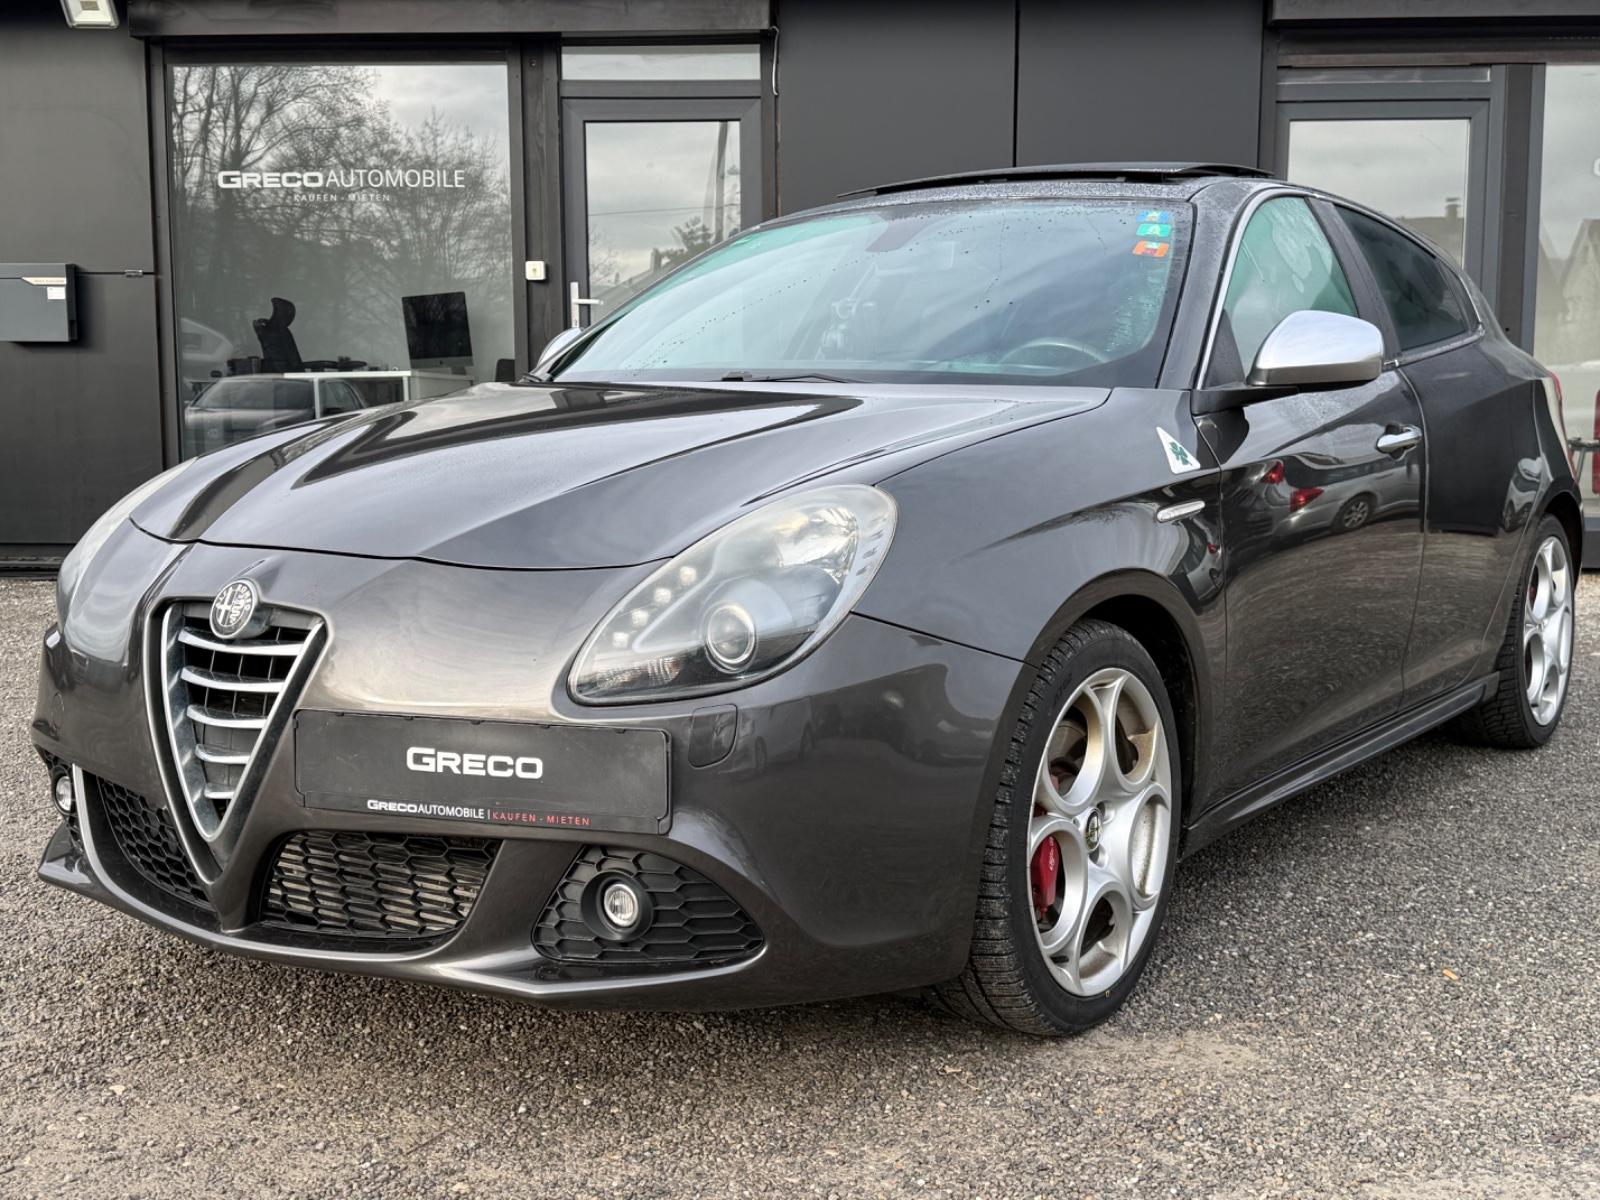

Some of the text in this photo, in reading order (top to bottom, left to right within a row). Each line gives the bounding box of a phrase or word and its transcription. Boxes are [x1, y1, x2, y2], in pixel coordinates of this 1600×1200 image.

[293, 193, 338, 202] KAUFEN
[348, 193, 390, 202] MIETEN
[406, 746, 543, 779] GRECO
[492, 811, 536, 823] KAUFEN
[546, 815, 590, 826] MIETEN
